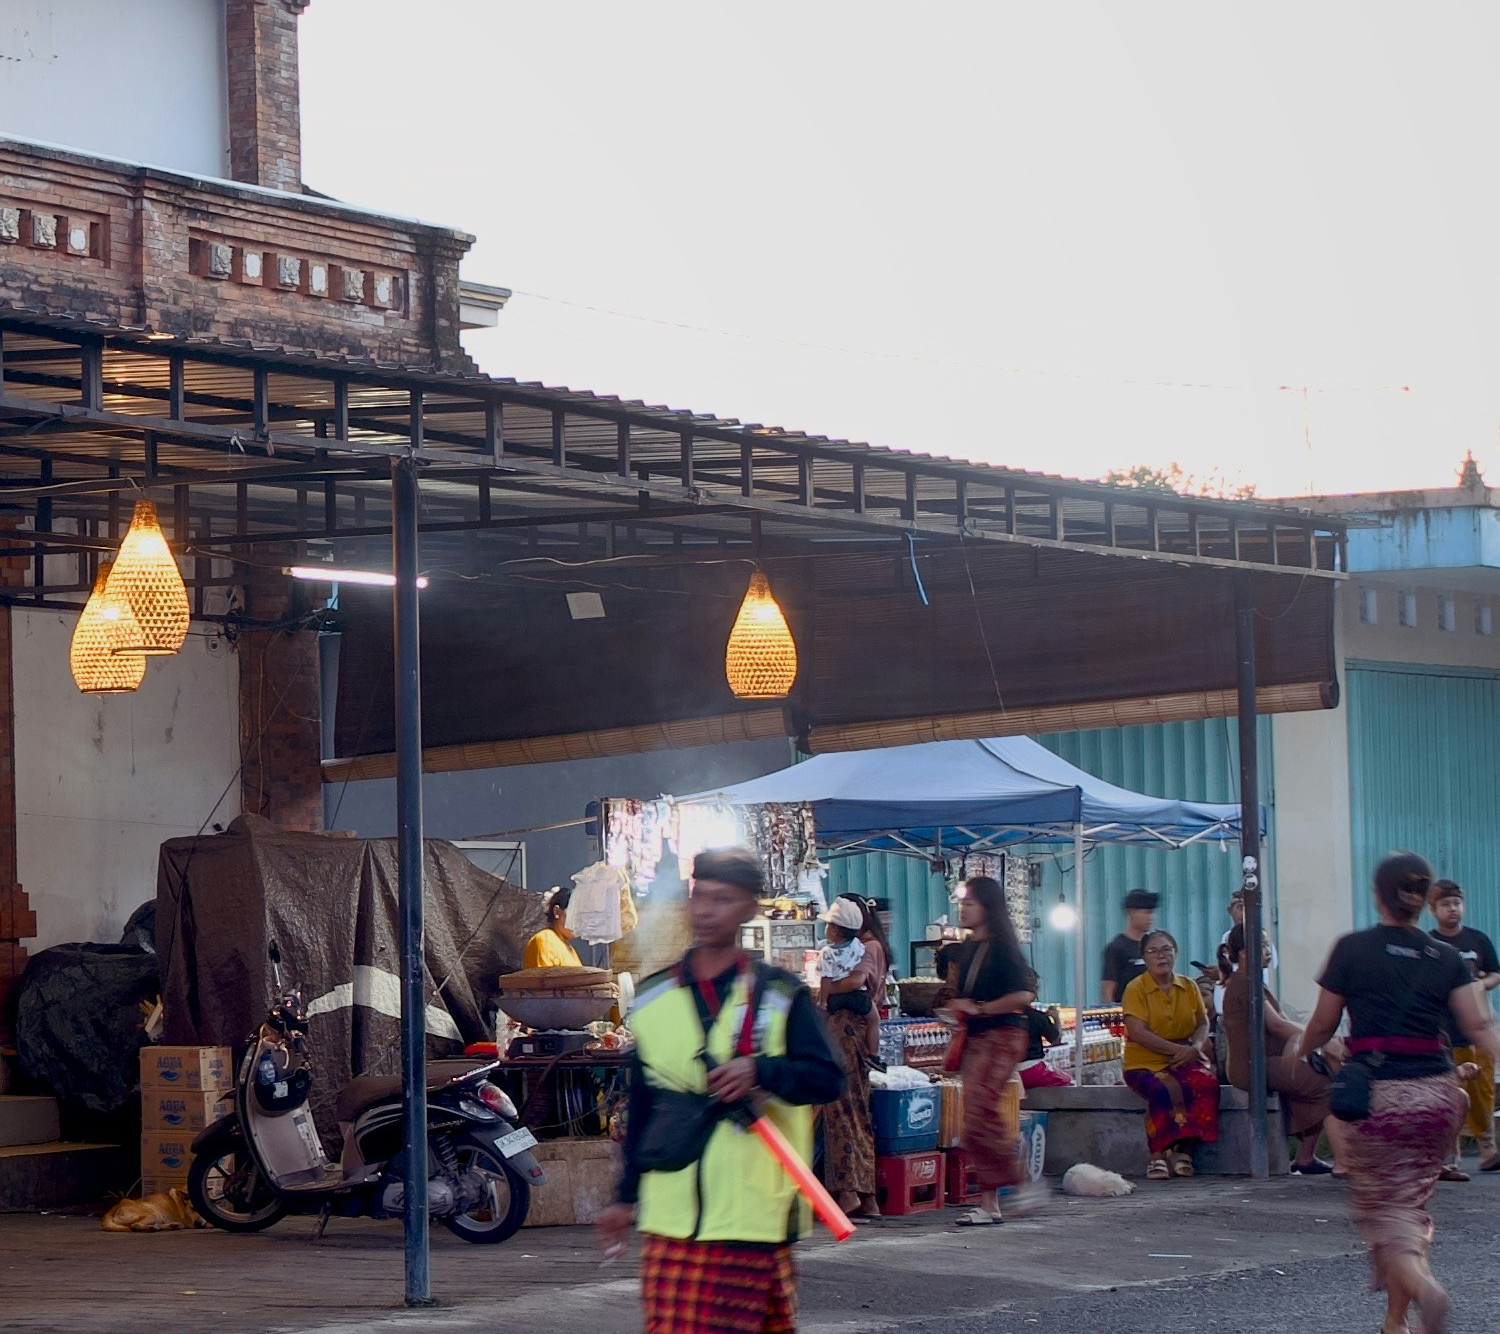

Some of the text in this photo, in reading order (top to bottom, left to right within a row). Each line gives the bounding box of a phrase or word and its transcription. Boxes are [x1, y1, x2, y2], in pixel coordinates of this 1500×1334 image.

[157, 1057, 182, 1068] AQUA
[160, 1100, 186, 1112] AQUA
[159, 1143, 185, 1155] AQUA
